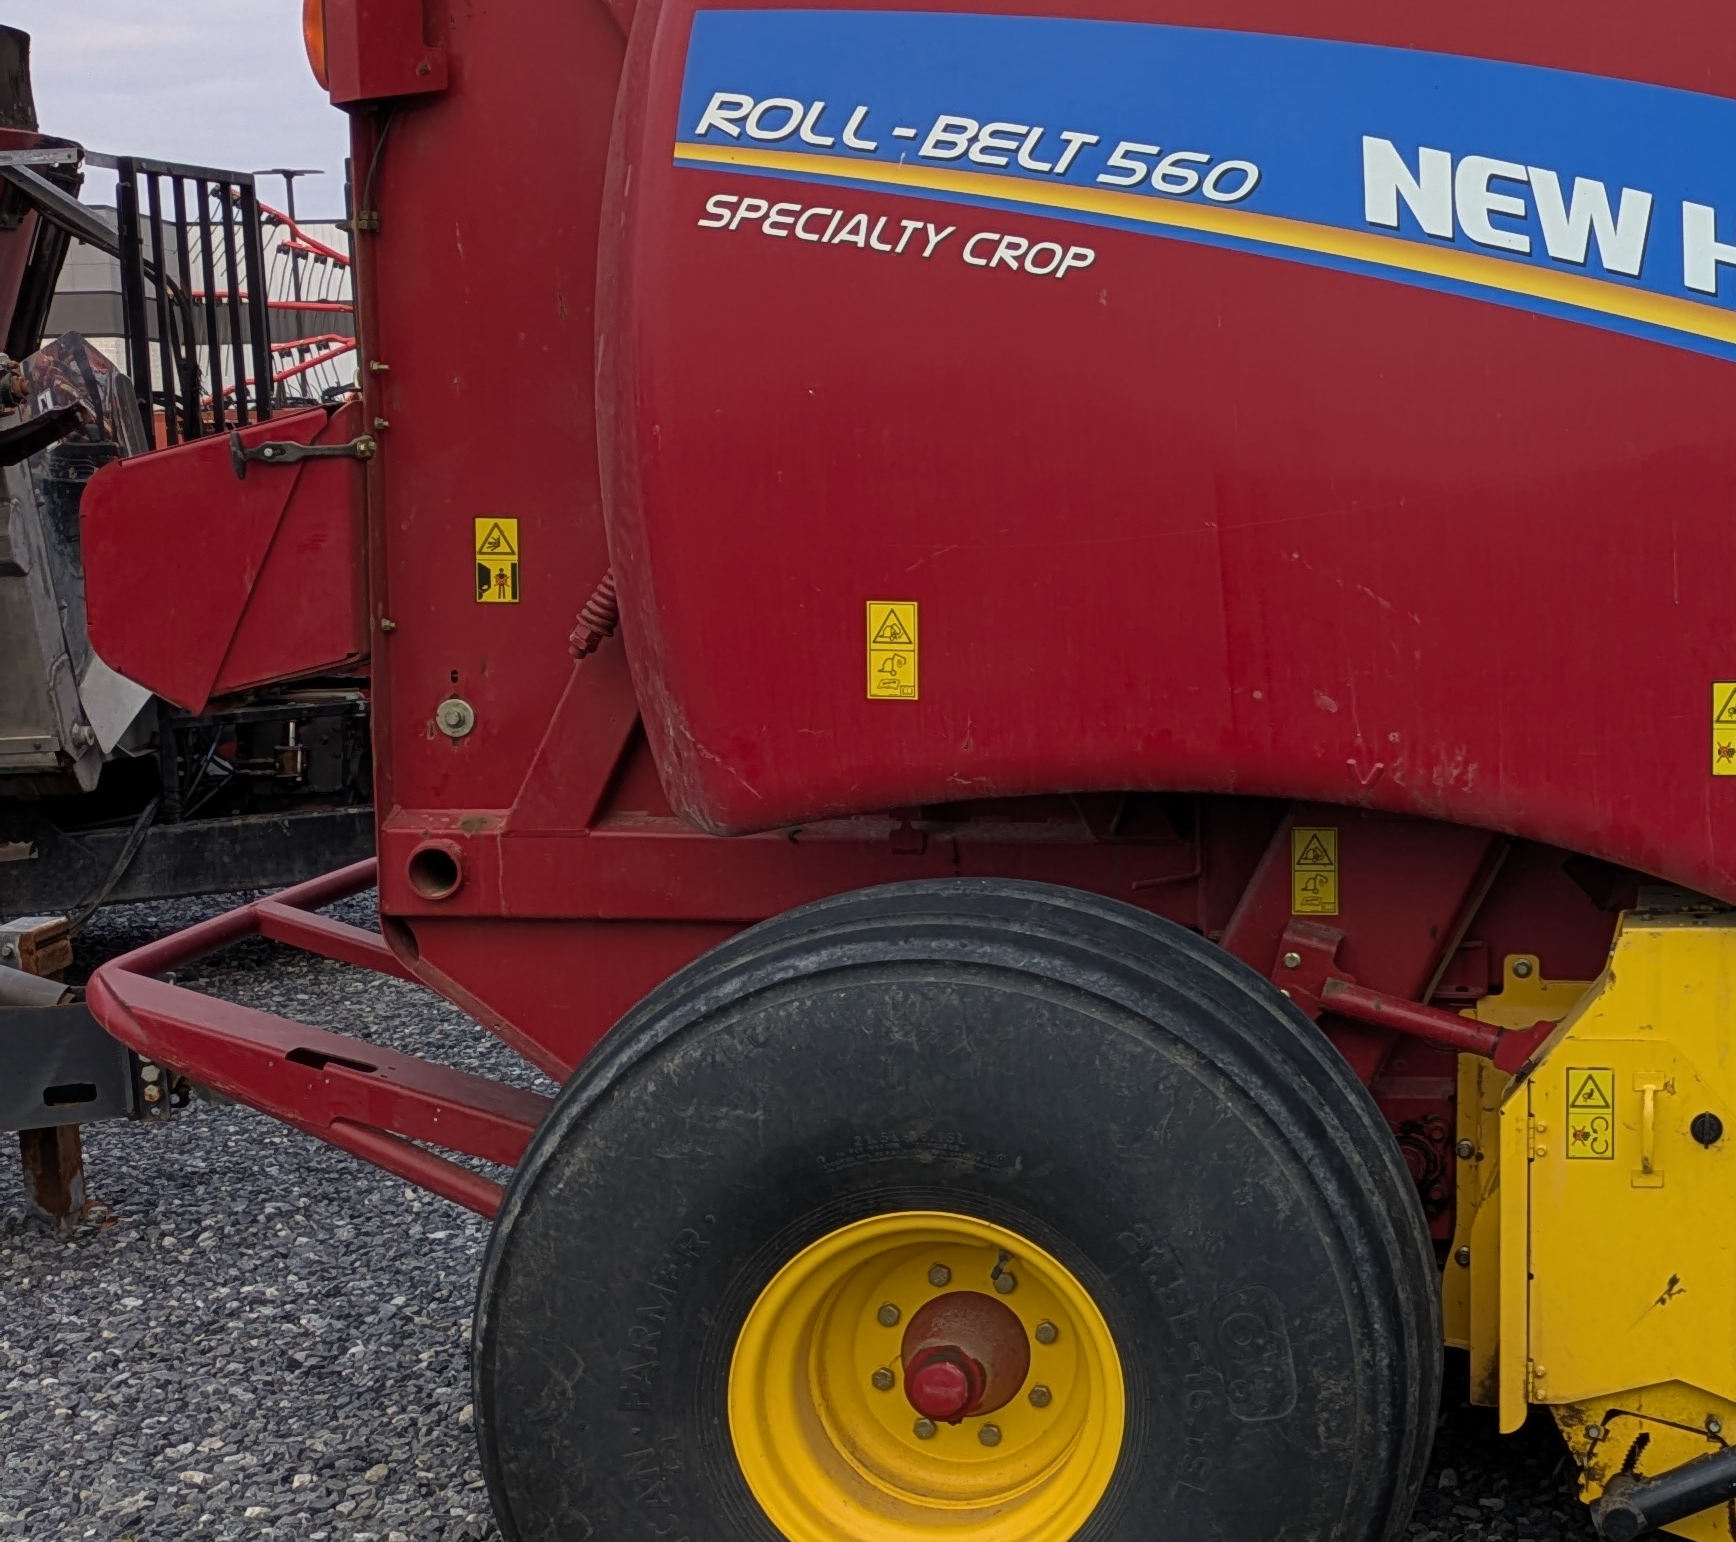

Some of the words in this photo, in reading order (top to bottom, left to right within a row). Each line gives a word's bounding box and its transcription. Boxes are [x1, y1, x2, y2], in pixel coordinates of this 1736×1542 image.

[694, 91, 1101, 176] ROLL-BELT
[1097, 141, 1261, 202] 560
[697, 195, 956, 258] SPECIALTY
[963, 232, 1096, 279] CROP
[1361, 134, 1652, 277] NEW
